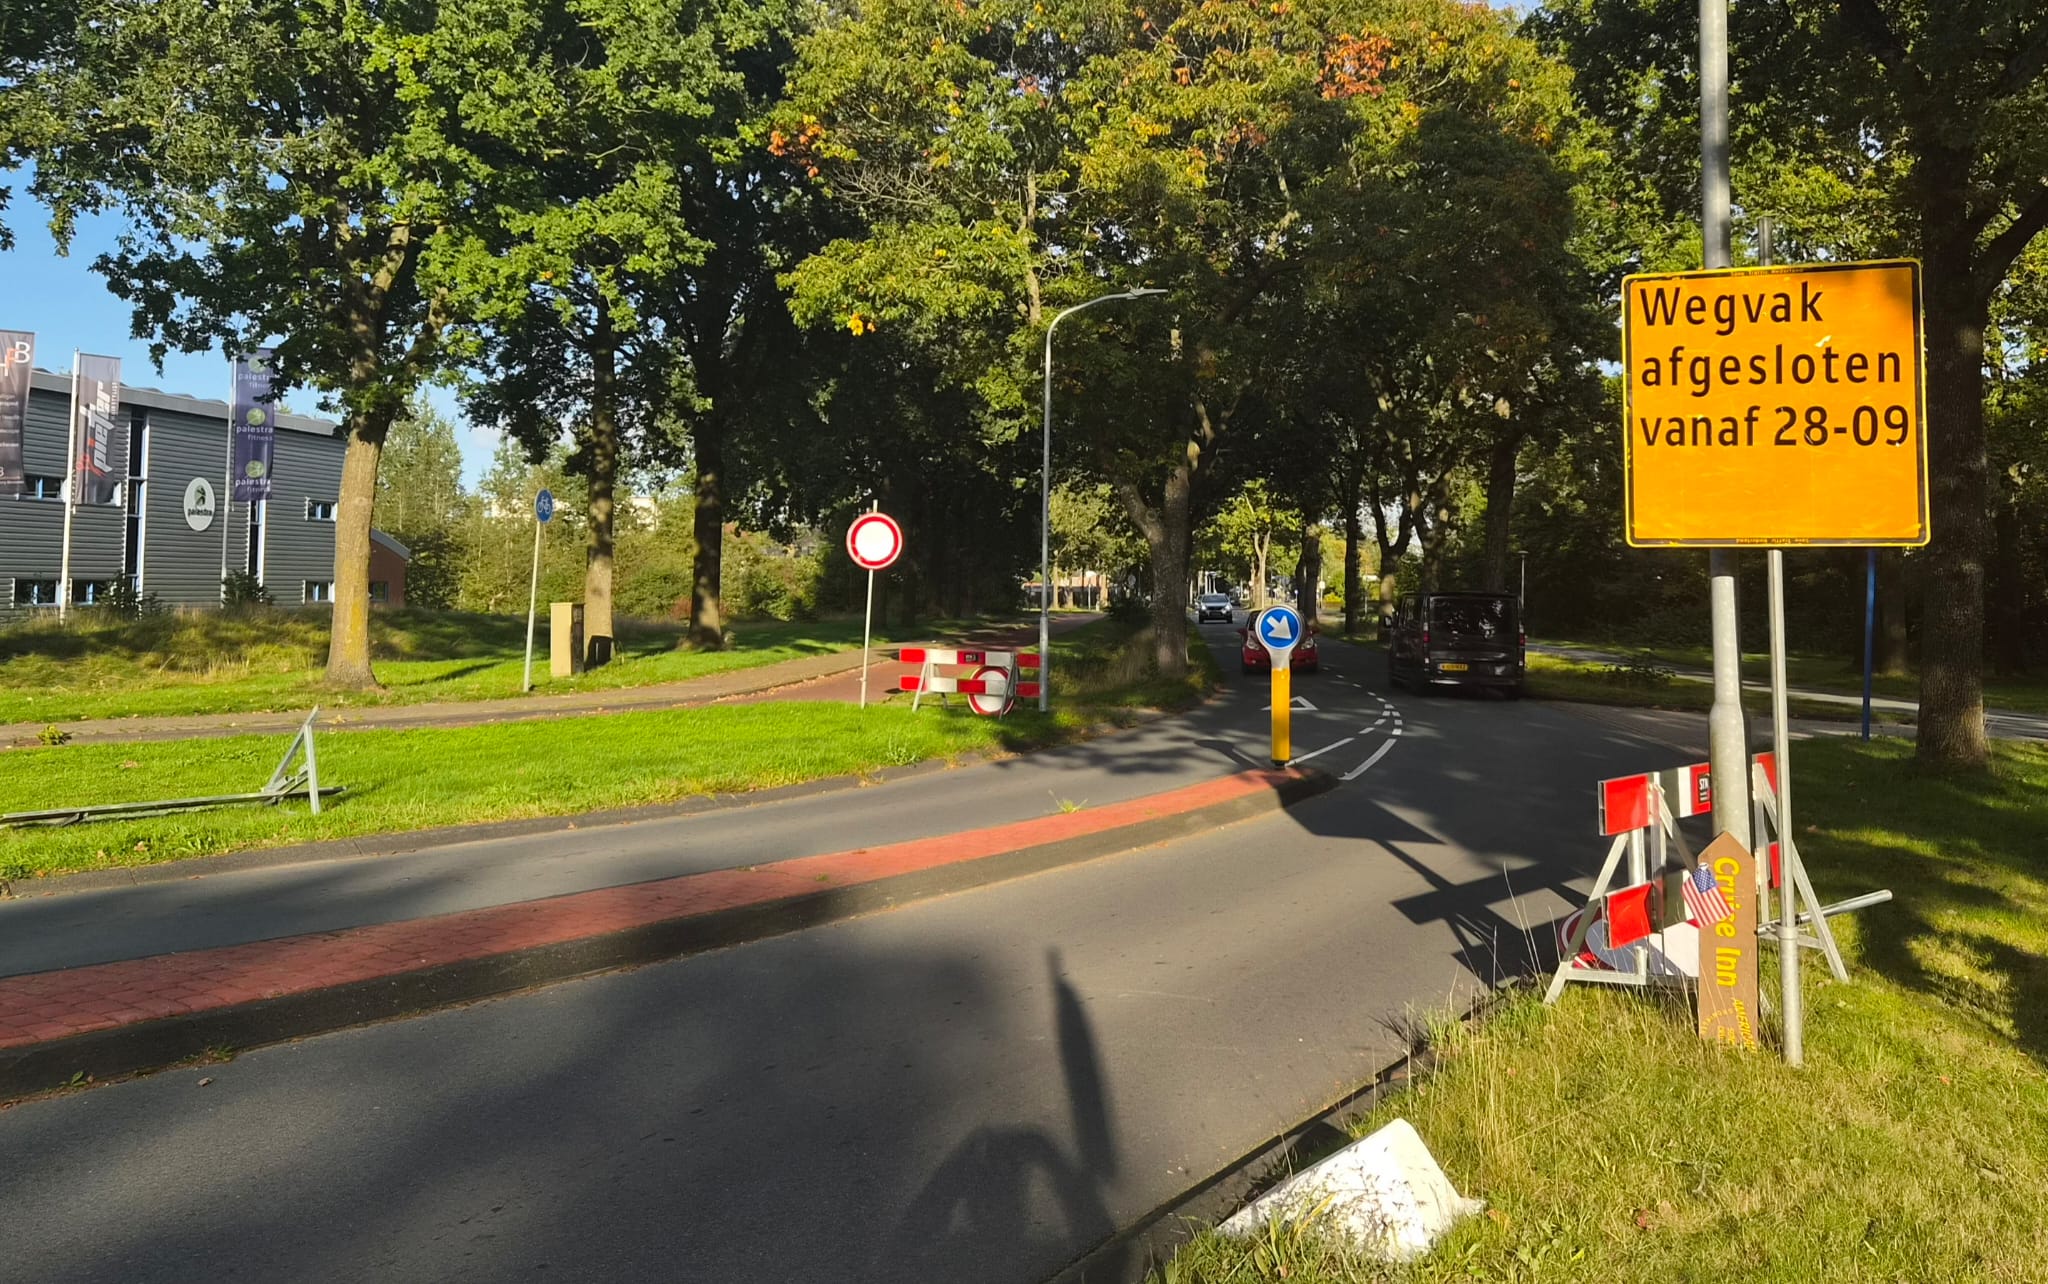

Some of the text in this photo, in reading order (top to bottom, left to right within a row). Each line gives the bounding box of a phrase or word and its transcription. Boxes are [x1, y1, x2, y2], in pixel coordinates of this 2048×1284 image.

[1640, 281, 1823, 336] Wegvak
[238, 372, 271, 382] palestr
[1641, 344, 1901, 397] afgesloten
[236, 425, 273, 434] palestra
[1640, 405, 1909, 447] vanaf 28-09
[235, 478, 271, 487] palestra
[187, 508, 213, 517] palestra
[1715, 946, 1742, 987] Inn
